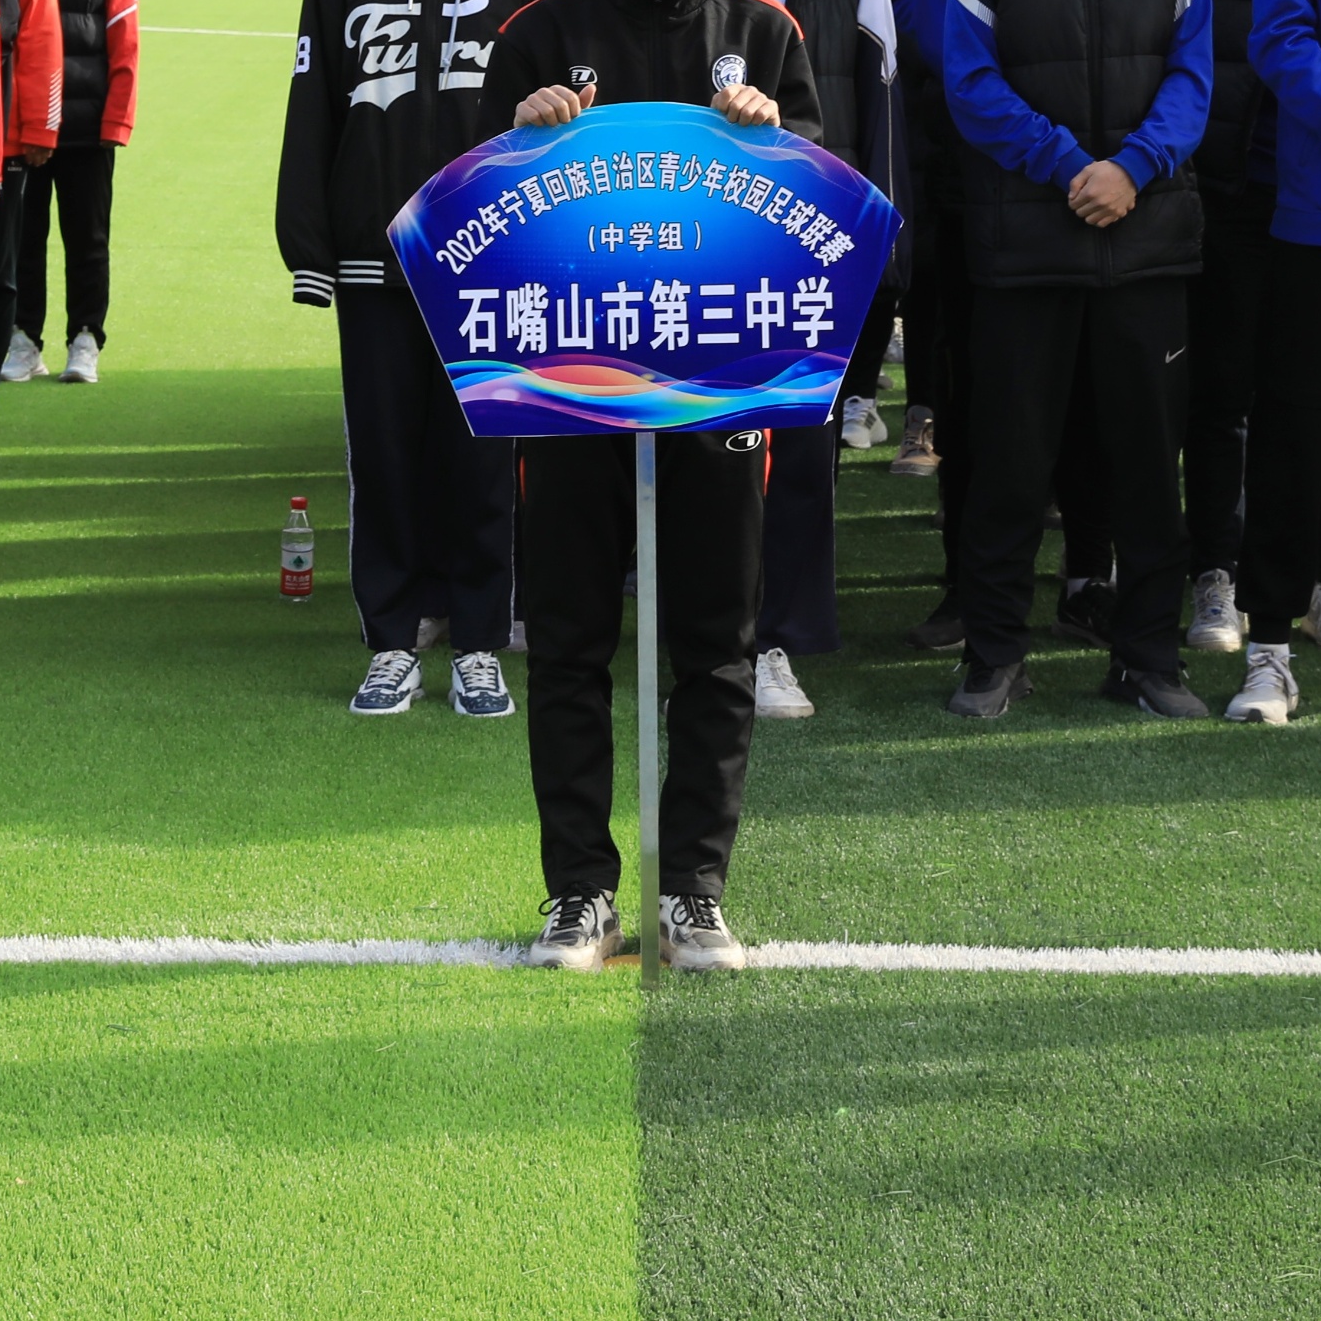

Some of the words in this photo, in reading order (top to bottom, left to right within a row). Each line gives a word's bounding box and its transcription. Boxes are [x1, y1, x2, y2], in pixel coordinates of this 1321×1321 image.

[435, 151, 855, 276] 2022年宁夏回族自治区青少年校园足球联赛
[458, 276, 835, 354] 石嘴山市第三中学
